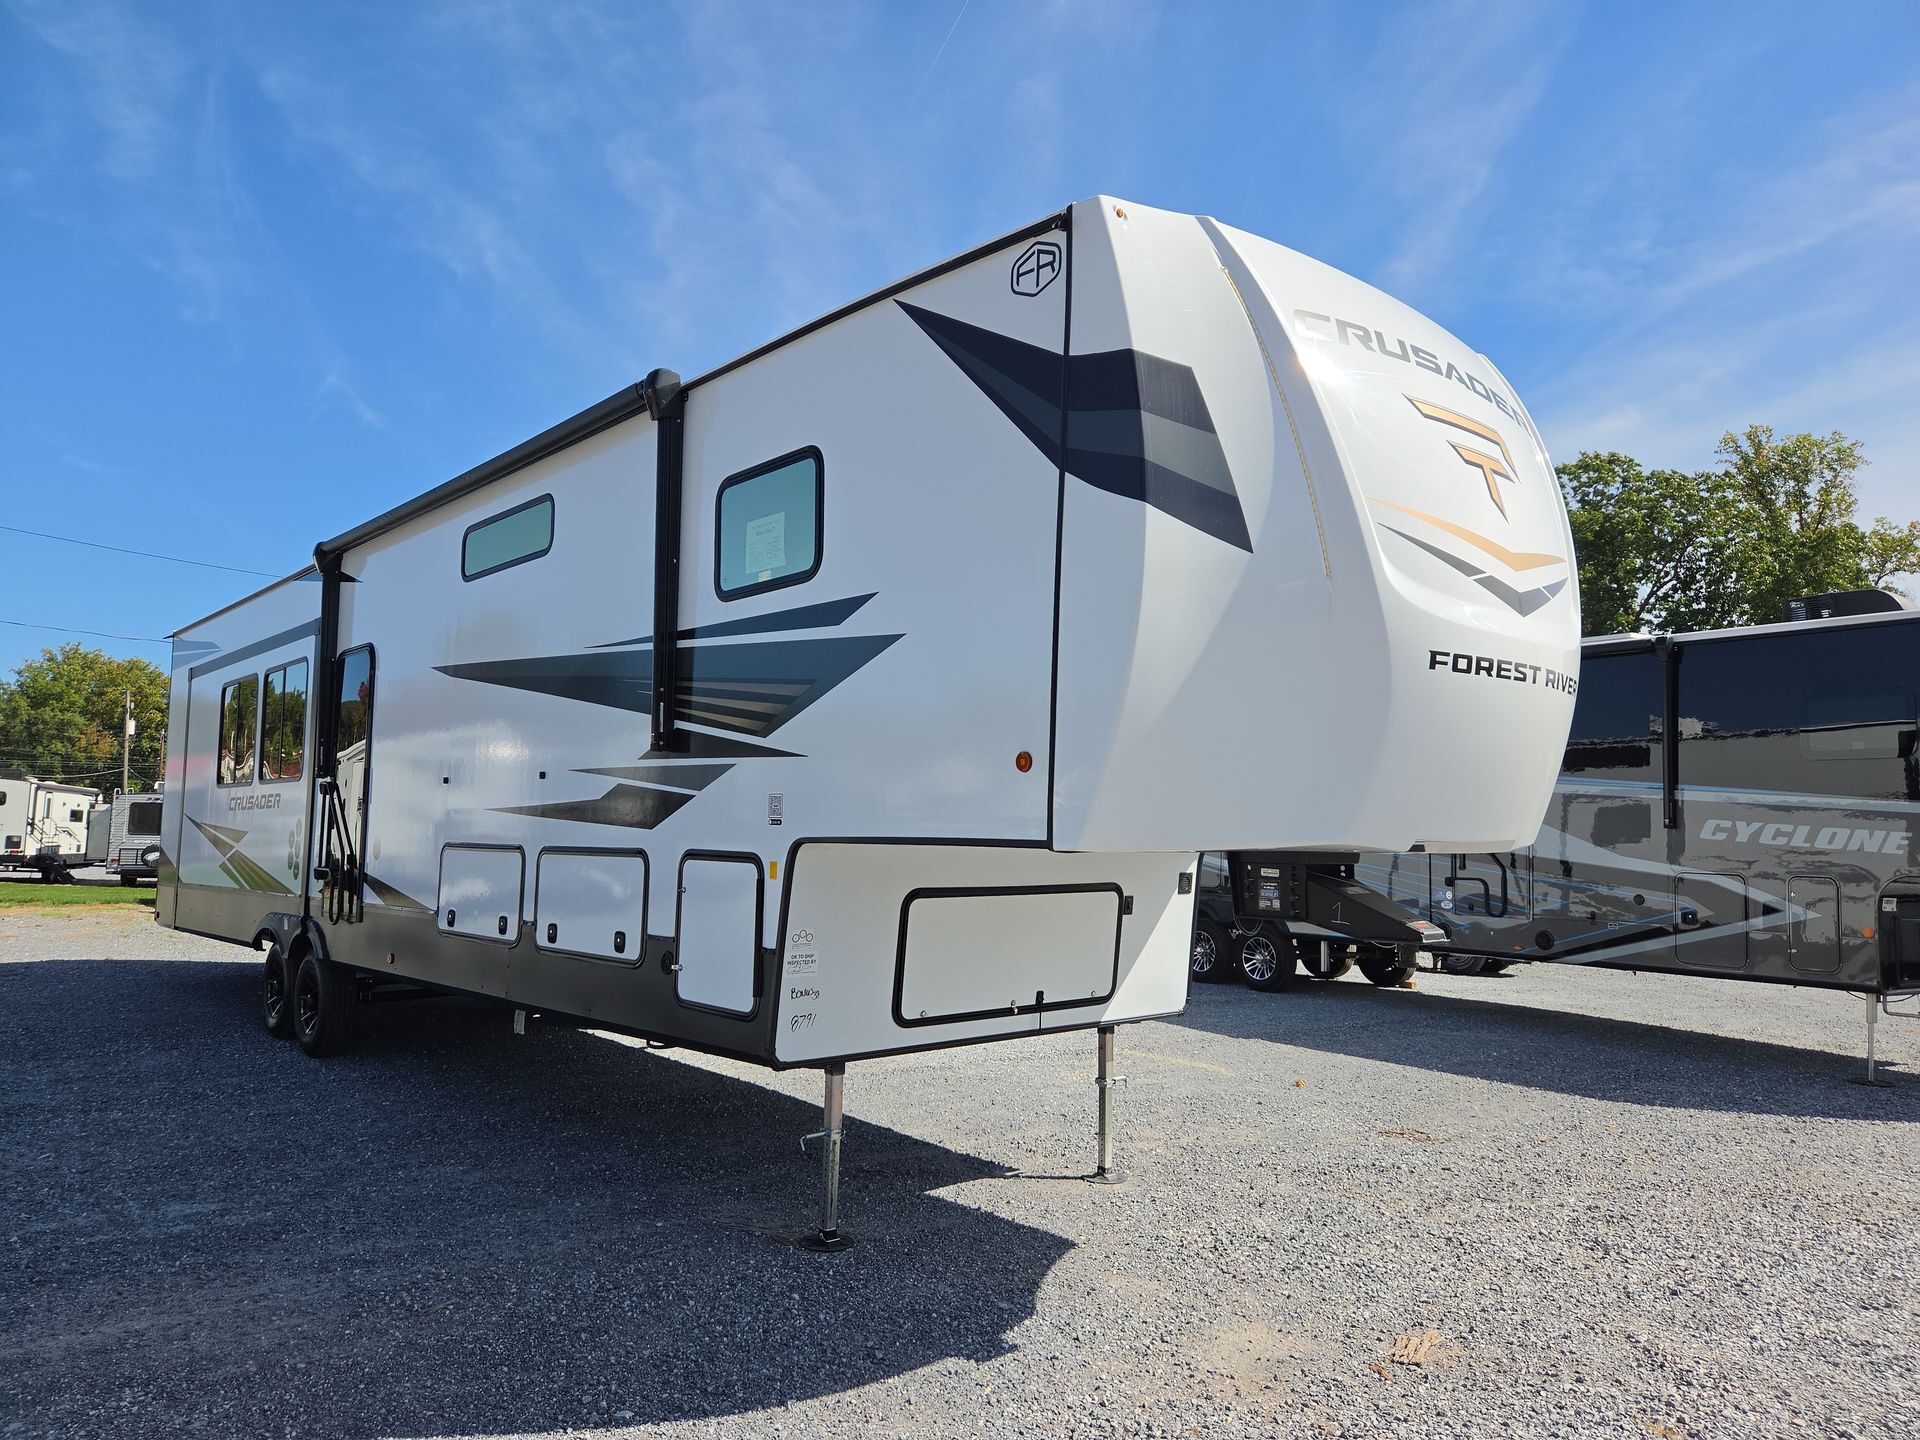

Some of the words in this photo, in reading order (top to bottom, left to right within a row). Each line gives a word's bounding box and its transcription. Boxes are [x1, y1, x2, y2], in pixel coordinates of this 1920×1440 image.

[1294, 308, 1534, 440] CRUSADER
[1428, 649, 1541, 684] FOREST
[229, 793, 281, 812] CRUSADER
[1699, 819, 1912, 855] CYCLONE
[791, 1013, 817, 1033] 8791
